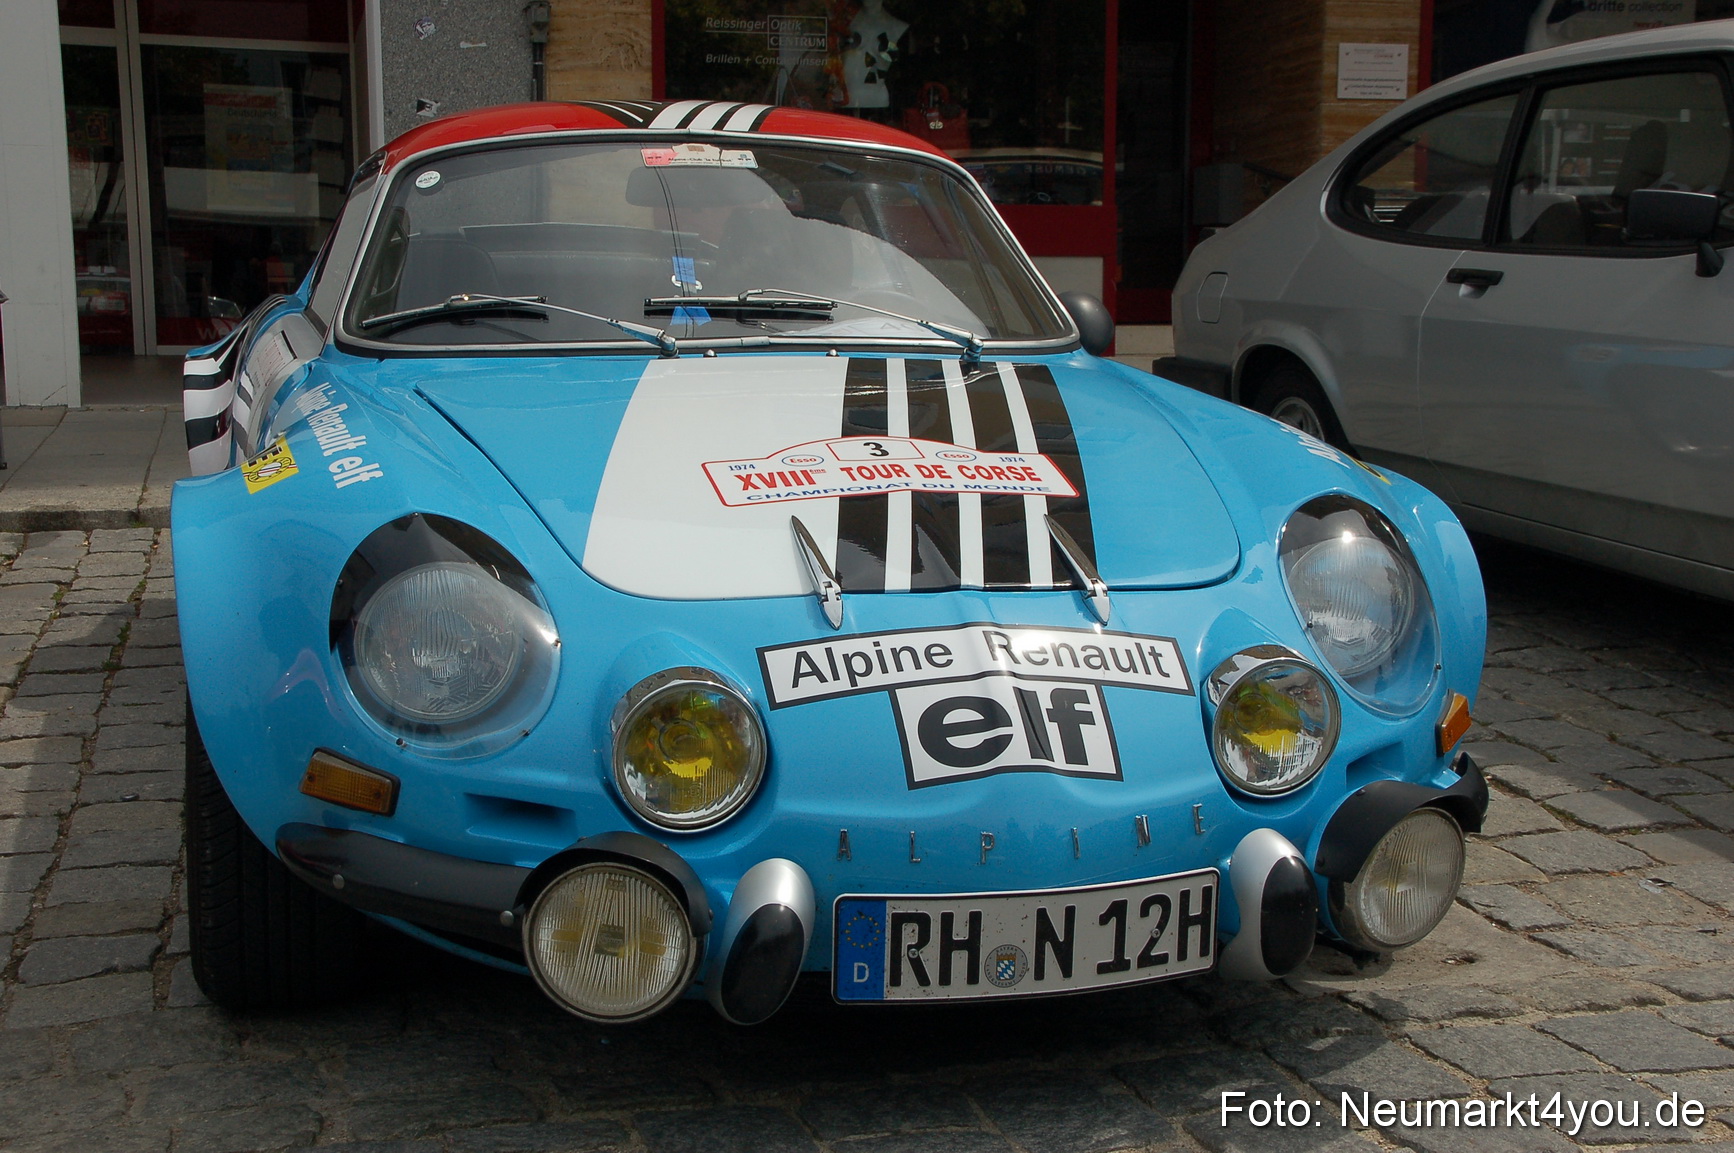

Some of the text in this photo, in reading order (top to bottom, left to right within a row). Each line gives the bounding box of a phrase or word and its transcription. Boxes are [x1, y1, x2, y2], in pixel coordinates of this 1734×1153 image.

[1629, 1, 1683, 12] collection
[706, 17, 802, 31] Reissinger Optik
[770, 37, 826, 47] CENTRUM
[705, 54, 741, 64] Brillen
[306, 403, 367, 457] Renault
[863, 442, 890, 457] 3
[328, 456, 384, 489] elf
[728, 463, 756, 472] 1974
[839, 464, 911, 482] TOUR
[914, 464, 953, 479] DE
[957, 464, 1043, 482] CORSE
[746, 482, 913, 501] CHAMPIONAT
[963, 484, 1052, 493] MONDE
[791, 629, 1171, 689] Alpine Renault
[917, 686, 1097, 768] elf
[836, 803, 1206, 865] ALPINE
[889, 885, 1214, 988] RH N 12H
[853, 962, 870, 984] D
